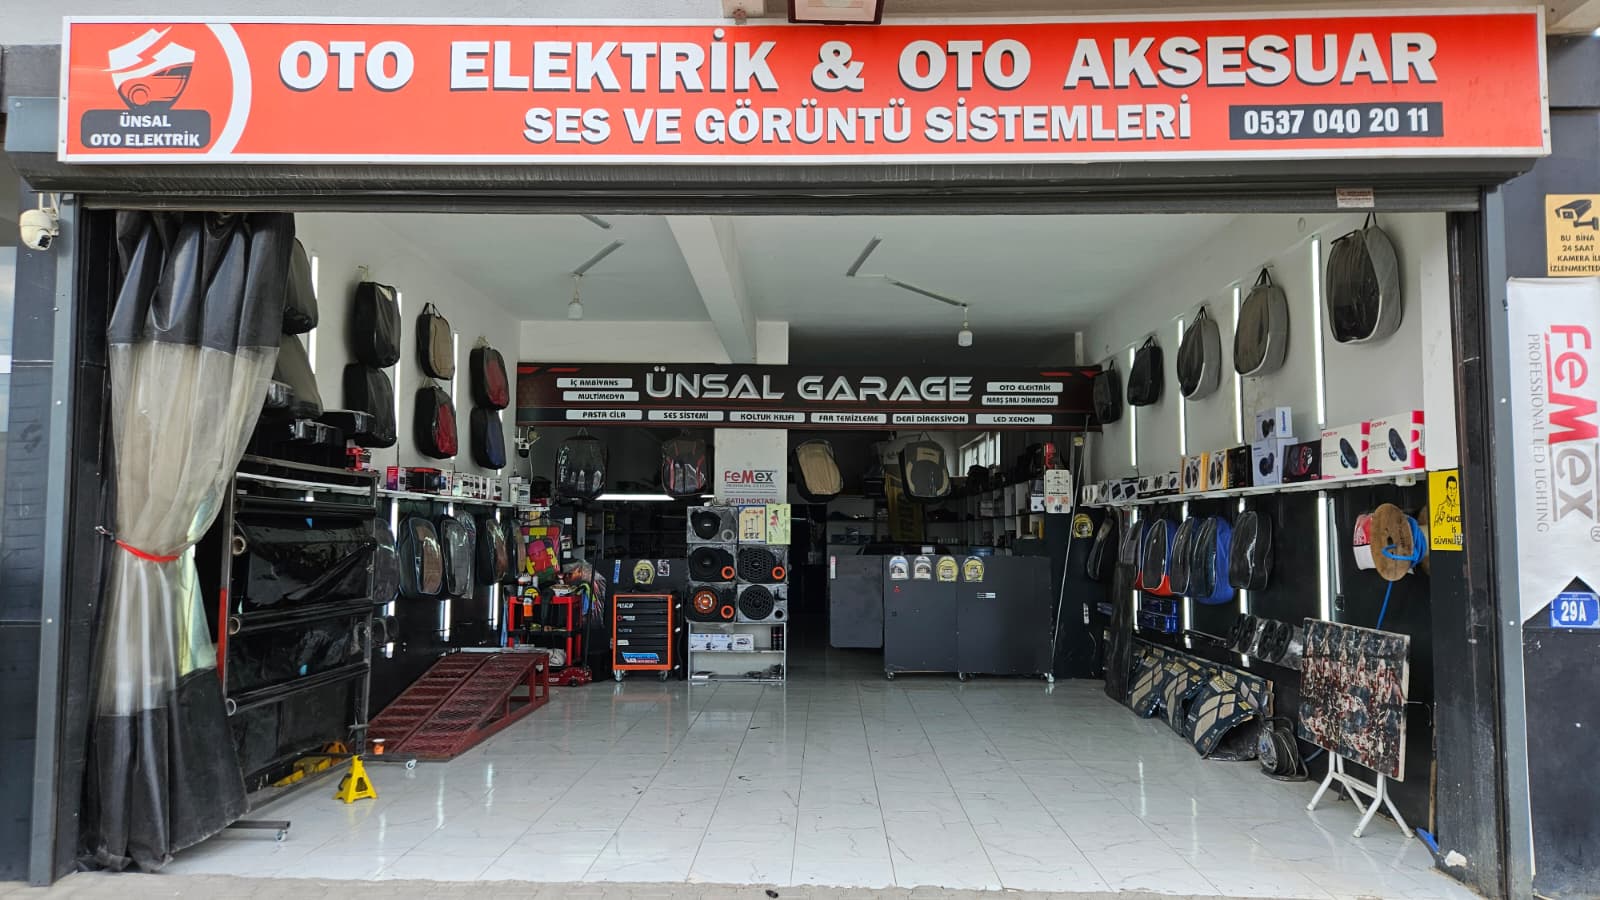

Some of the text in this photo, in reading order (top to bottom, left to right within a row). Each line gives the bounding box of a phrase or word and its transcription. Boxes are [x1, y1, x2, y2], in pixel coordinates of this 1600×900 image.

[279, 28, 1438, 92] OTO ELEKTRİK & OTO AKSESUAR
[120, 112, 171, 128] ÜNSAL
[524, 95, 1191, 143] SES VE GÖRÜNTÜ SİSTEMLERİ
[1244, 108, 1429, 135] 0537 040 20 11
[90, 131, 200, 146] OTO ELEKTRİK
[1576, 233, 1595, 241] BİNA
[570, 379, 578, 387] İÇ
[646, 366, 973, 401] ÜNSAL GARAGE
[609, 410, 626, 418] CİLA
[837, 414, 878, 422] TEMİZLEME
[917, 414, 965, 422] DİREKSİYON
[1527, 334, 1549, 532] PROFESSIONAL LED LIGHTING
[1561, 600, 1587, 622] 29A
